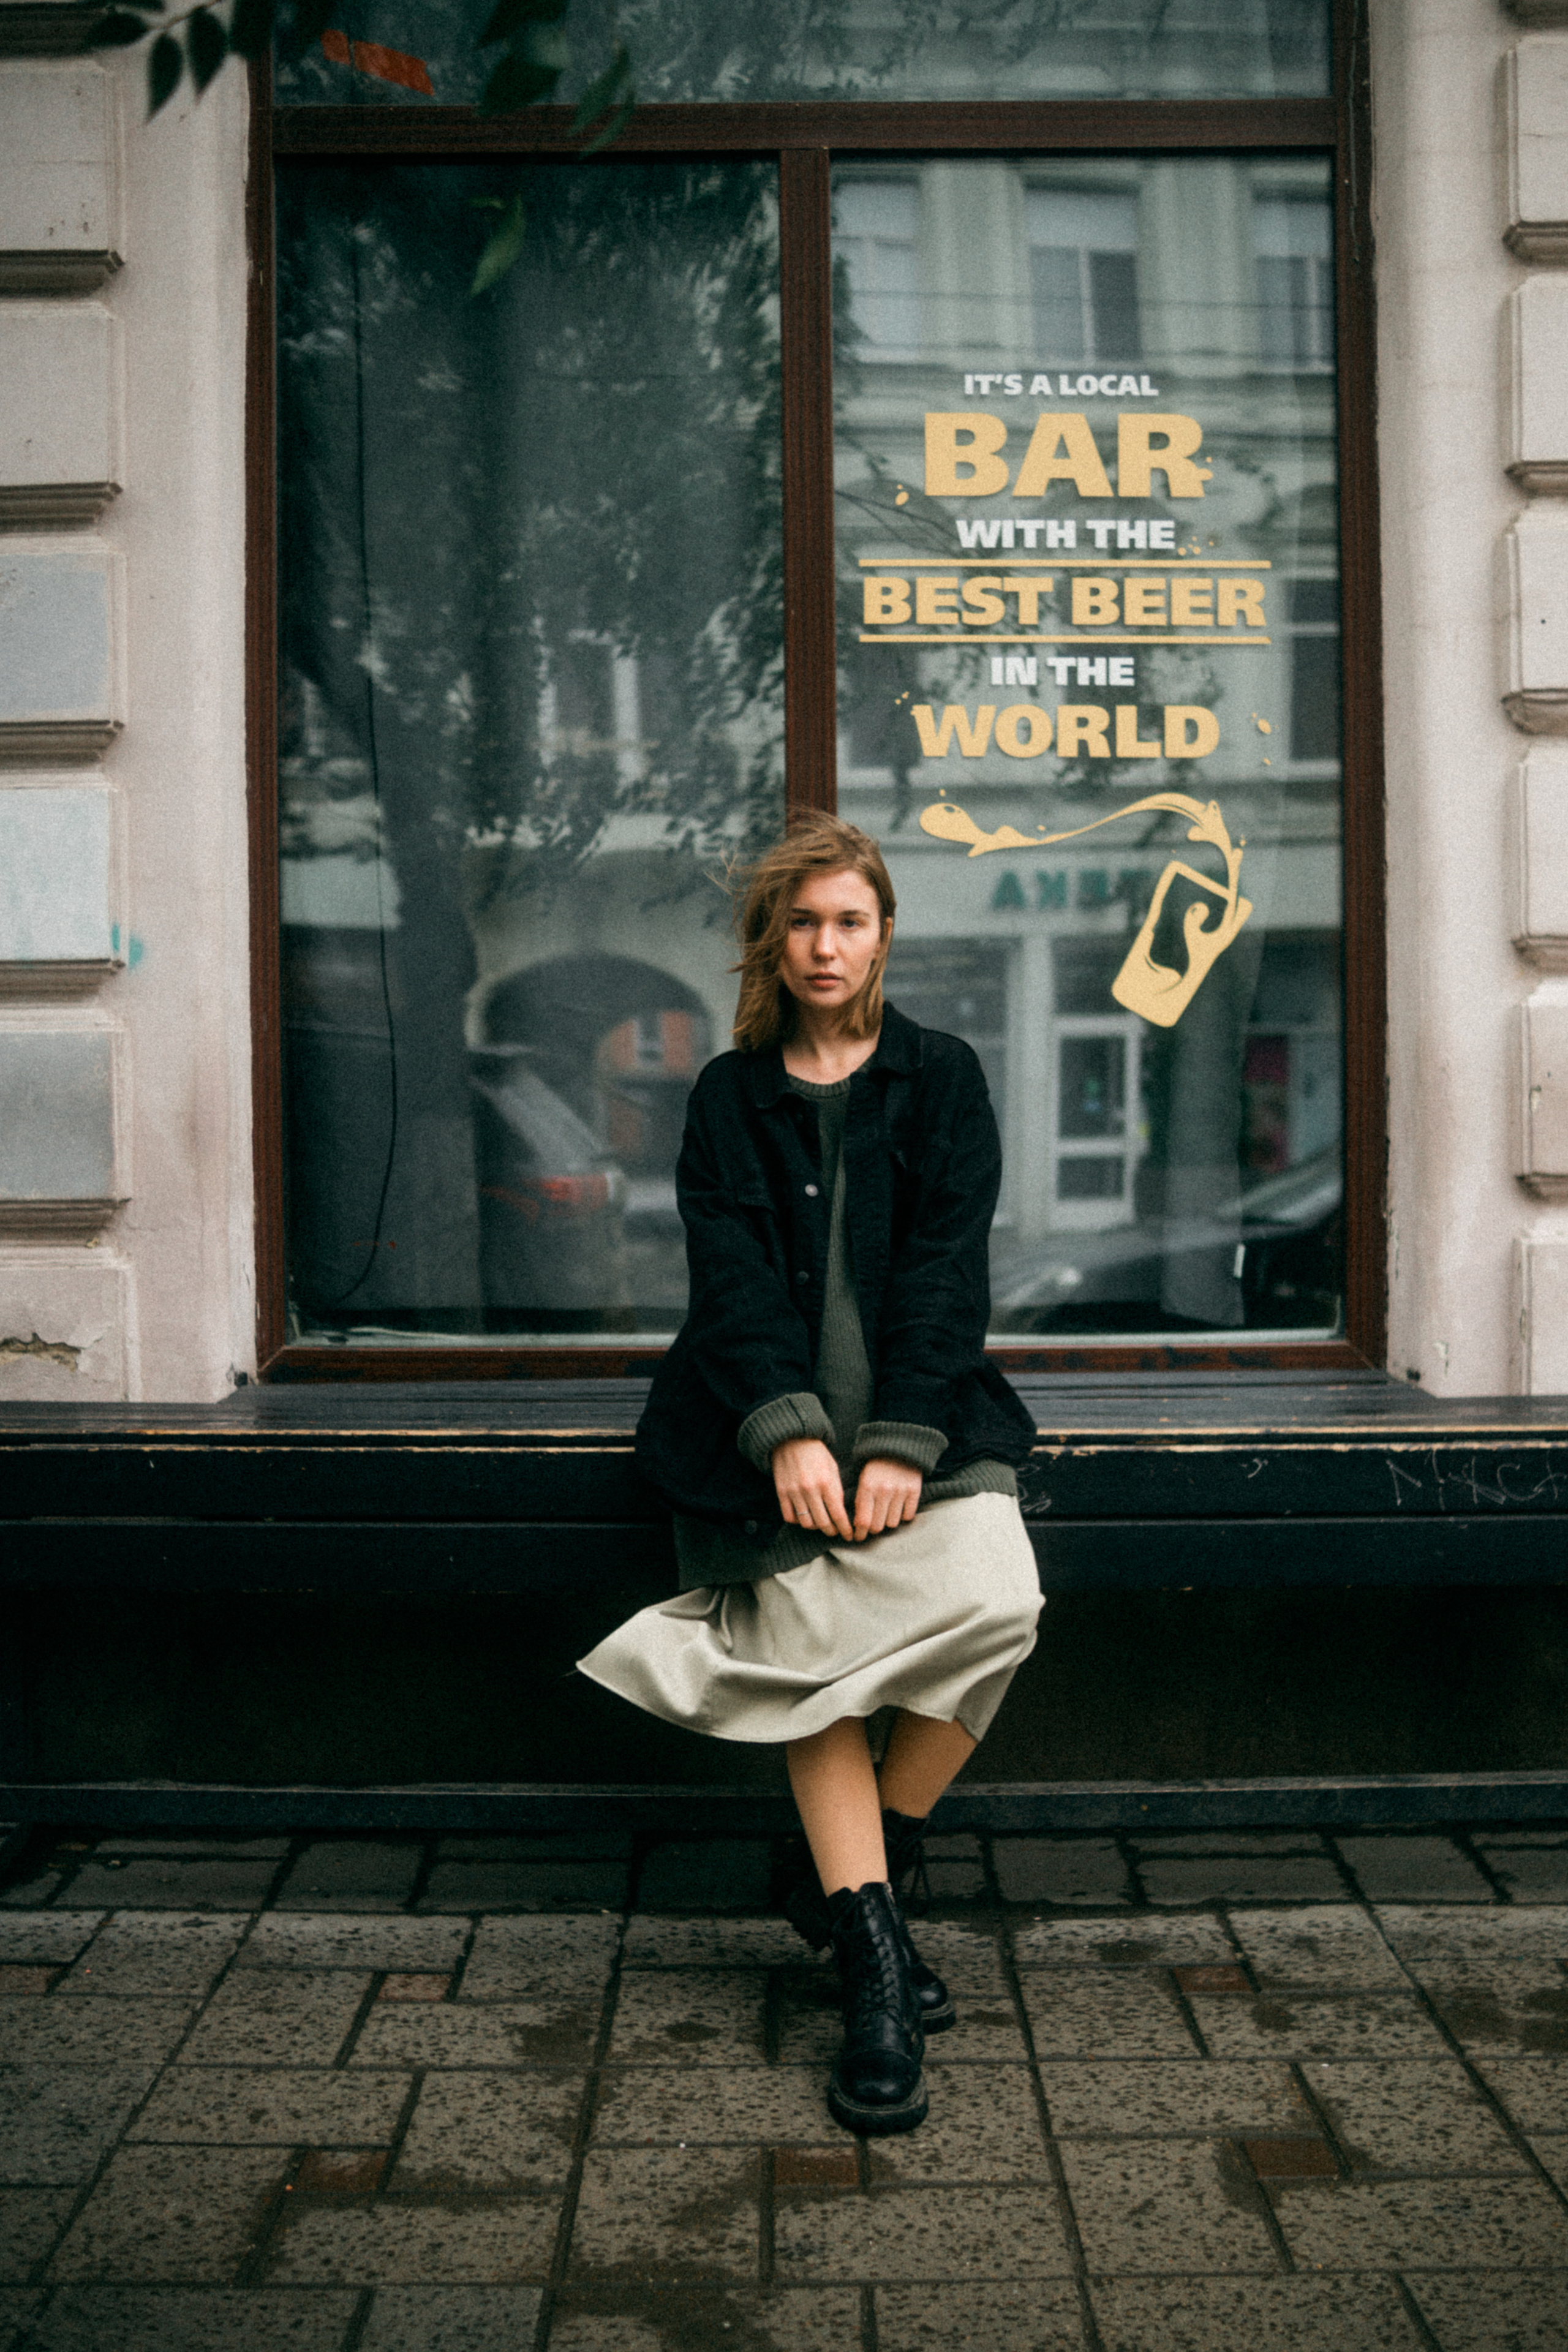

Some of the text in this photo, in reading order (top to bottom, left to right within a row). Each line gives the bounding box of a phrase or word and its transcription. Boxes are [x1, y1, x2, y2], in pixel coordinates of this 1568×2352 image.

[964, 374, 1159, 396] IT'S A LOCAL
[924, 412, 1207, 498] BAR
[956, 519, 1175, 549] WITH THE
[863, 576, 1267, 627] BEST BEER
[990, 656, 1134, 686] IN THE
[910, 704, 1220, 759] WORLD
